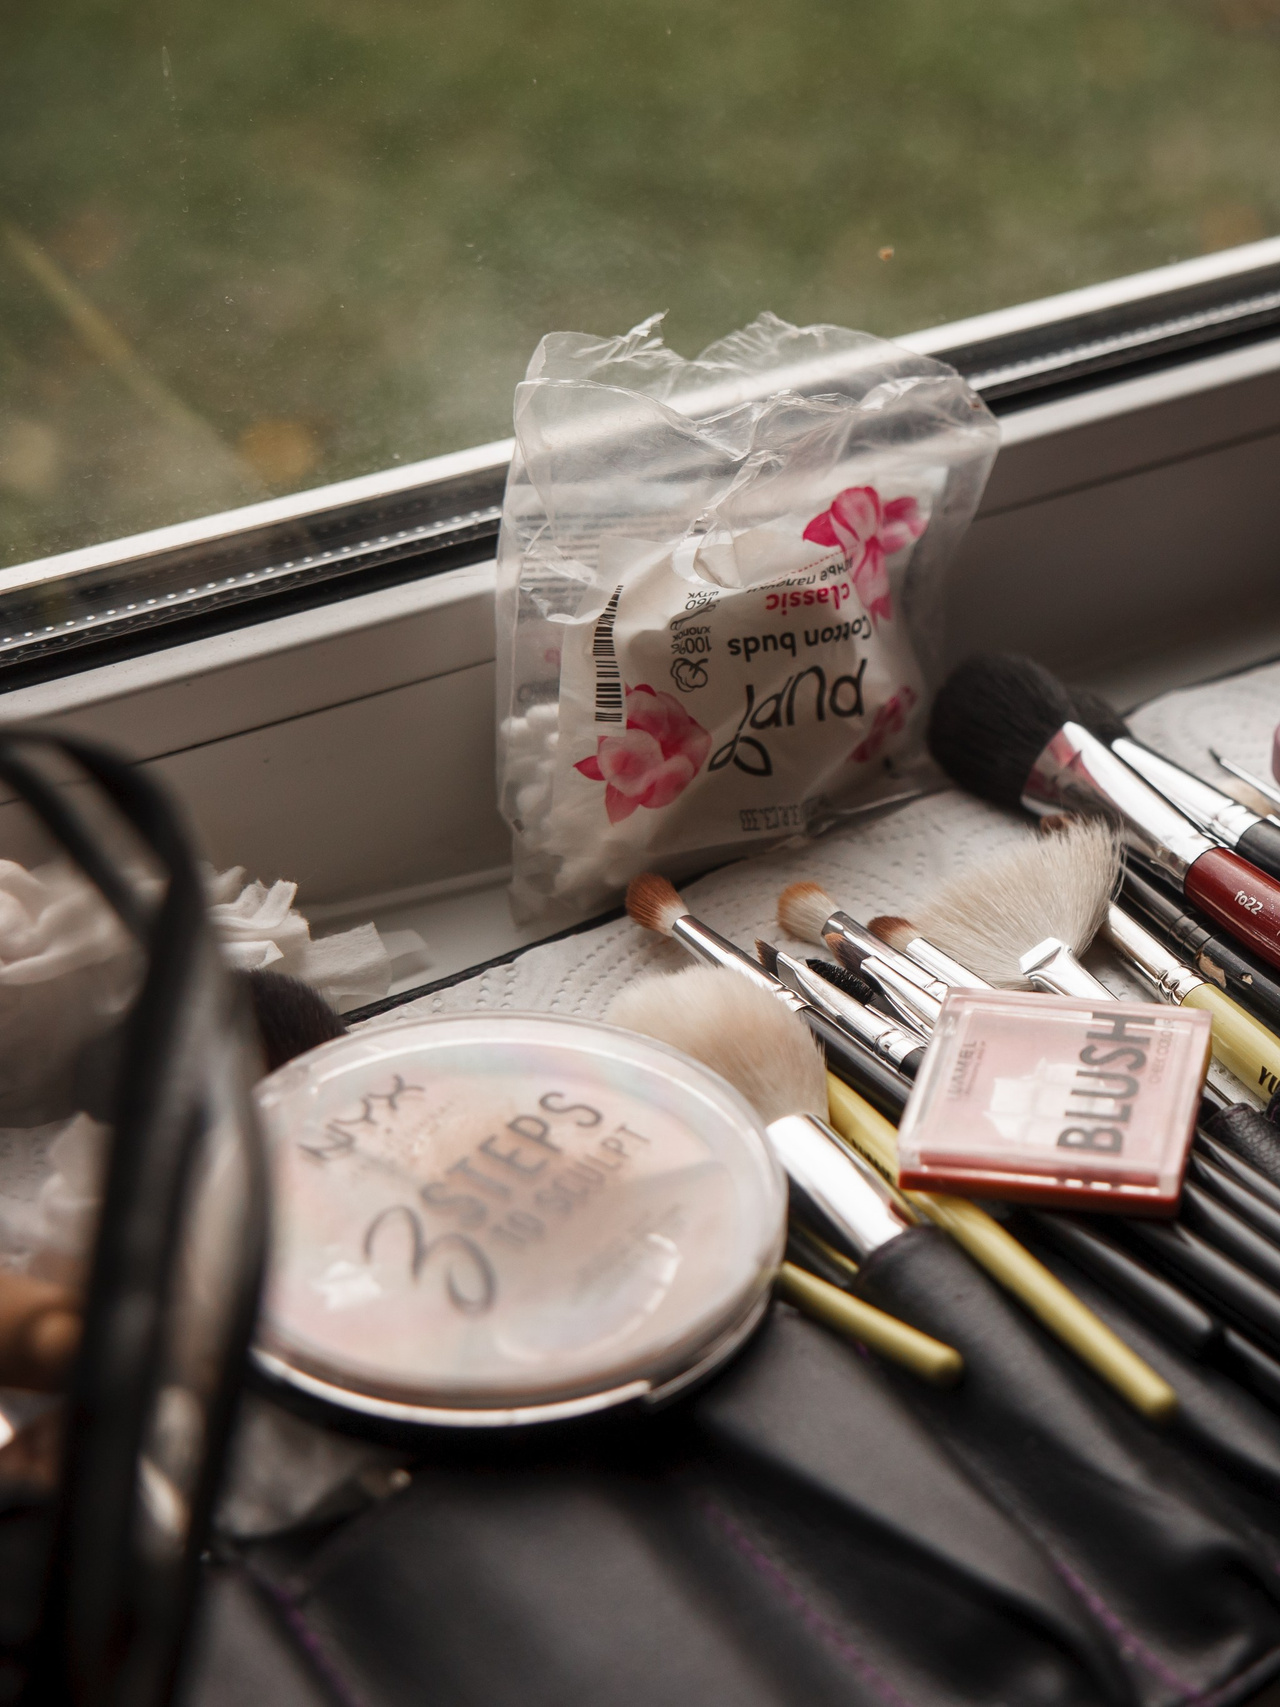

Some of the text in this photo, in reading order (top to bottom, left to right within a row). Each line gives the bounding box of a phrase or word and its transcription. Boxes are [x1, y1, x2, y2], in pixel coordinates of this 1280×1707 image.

[671, 624, 712, 642] хлопок
[684, 596, 713, 611] 160
[765, 581, 851, 616] classic
[670, 634, 712, 655] 100%
[726, 614, 873, 663] Cotton buds
[1057, 1011, 1156, 1154] BLUSH
[296, 1073, 427, 1168] NYX
[421, 1090, 604, 1230] STEPS
[534, 1122, 654, 1217] SCULPT
[362, 1203, 499, 1315] 3
